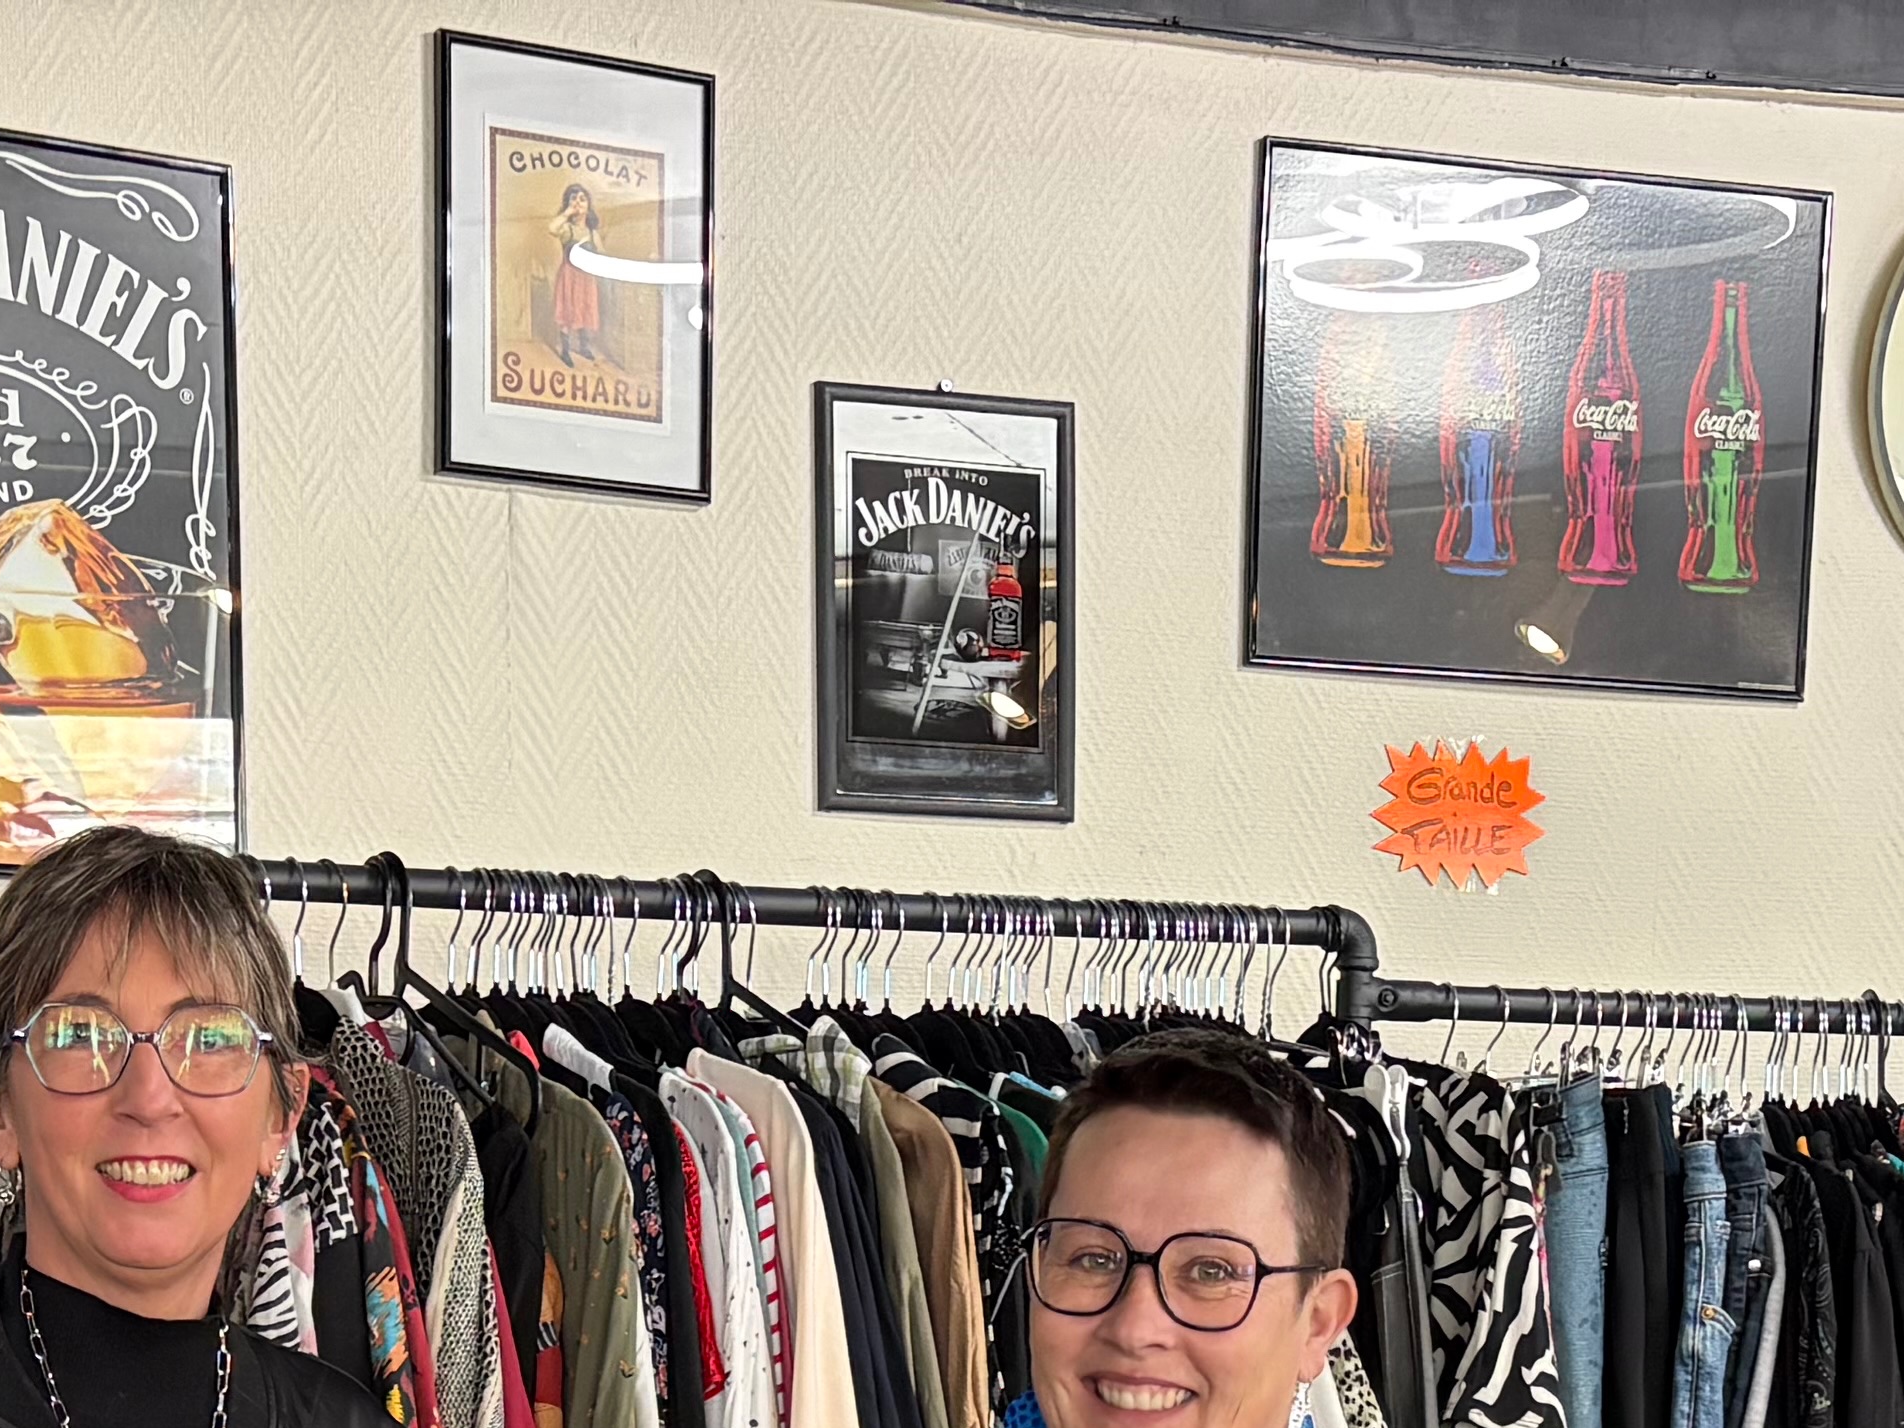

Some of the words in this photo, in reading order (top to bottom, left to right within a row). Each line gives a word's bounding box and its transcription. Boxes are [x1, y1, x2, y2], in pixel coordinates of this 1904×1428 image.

[509, 149, 649, 188] CHOCOLAT
[501, 350, 652, 411] SUCHARD
[1572, 397, 1640, 433] Coca-Cola
[1693, 407, 1762, 442] Coca-Cola
[904, 466, 950, 479] BREAK
[855, 488, 926, 547] JACK
[1407, 766, 1518, 809] Grande
